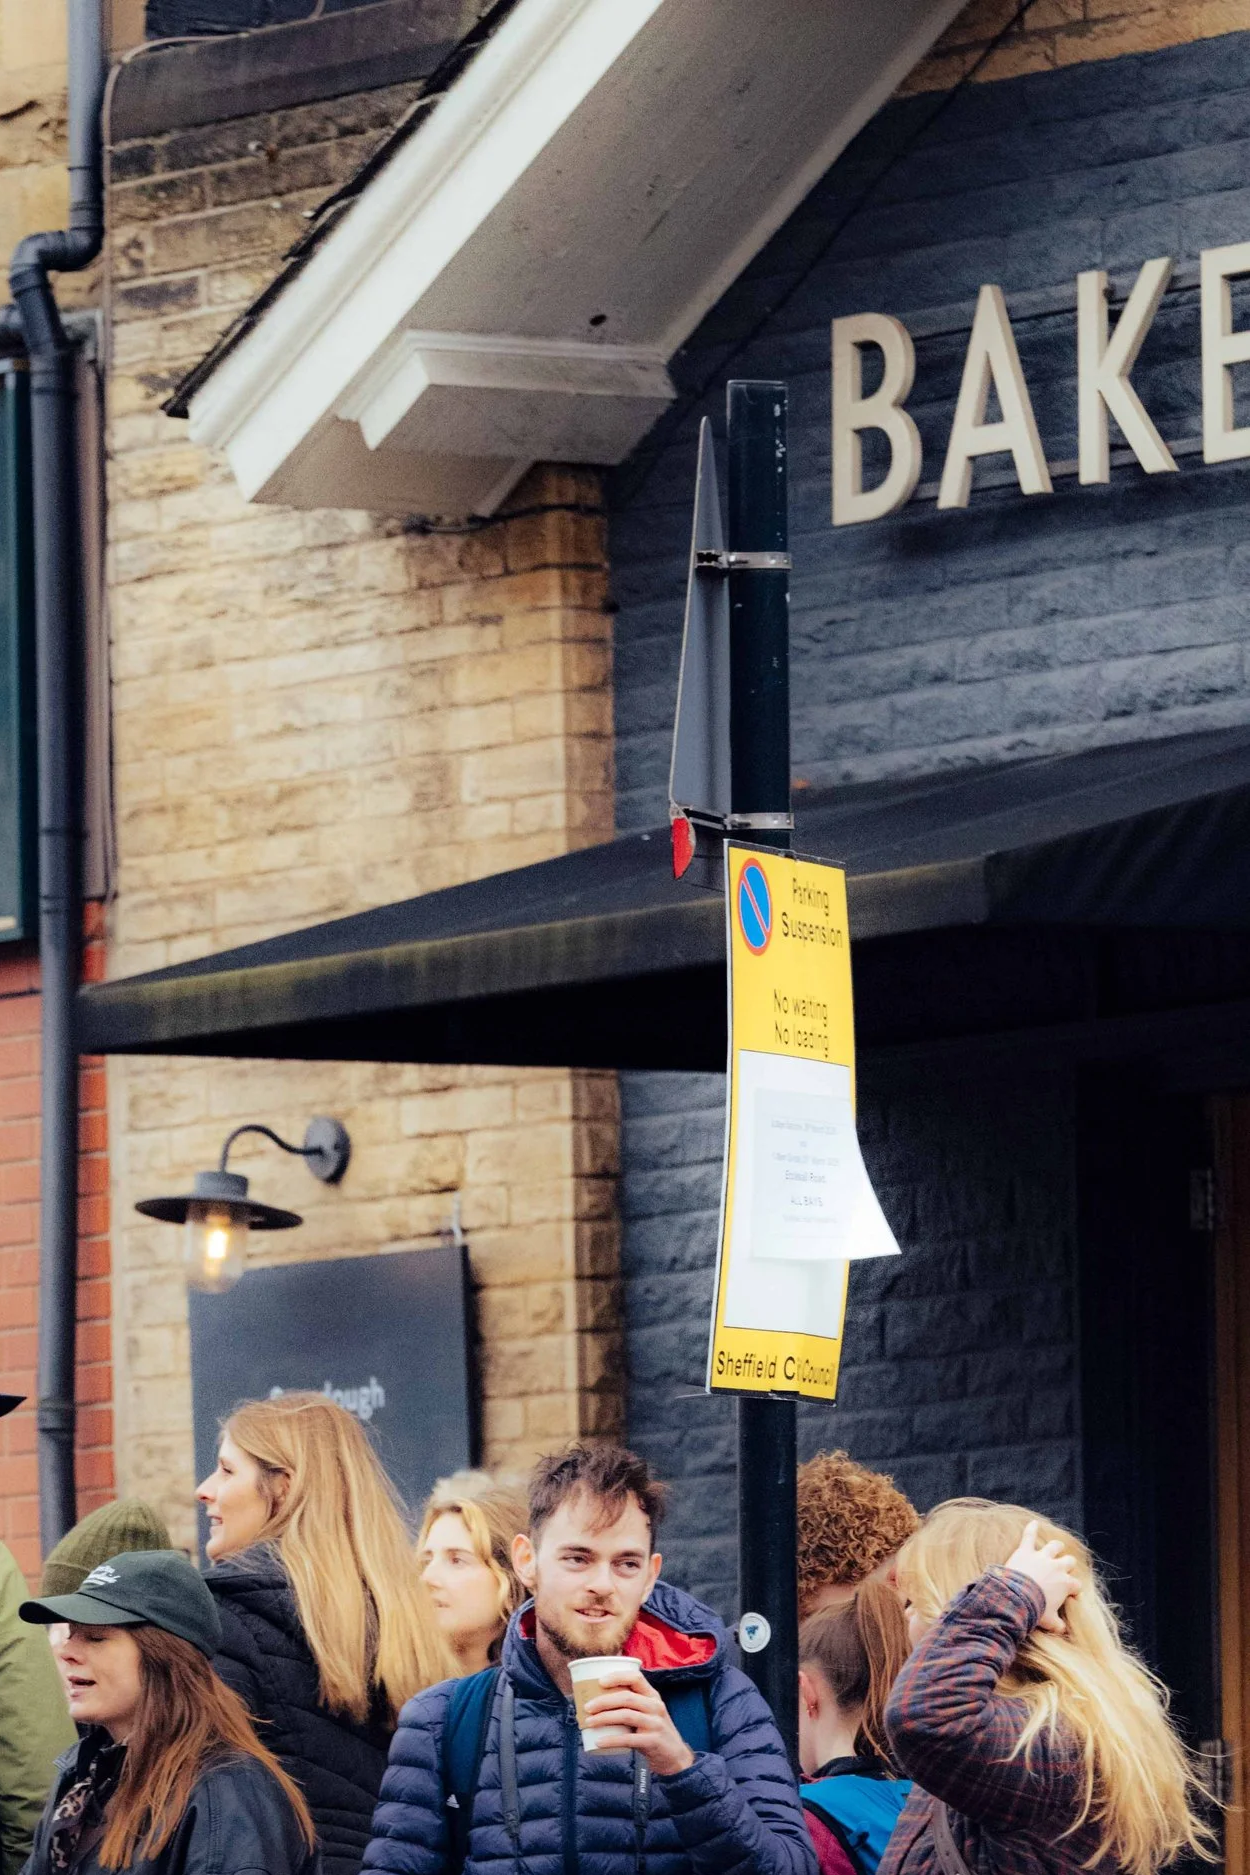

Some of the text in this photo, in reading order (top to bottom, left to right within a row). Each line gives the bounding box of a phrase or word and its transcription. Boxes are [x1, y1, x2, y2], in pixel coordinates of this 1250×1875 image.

[831, 240, 1250, 526] BAKE
[792, 877, 830, 918] Parking
[781, 911, 844, 949] Suspension
[773, 988, 828, 1028] No waiting
[774, 1020, 829, 1058] No loading
[716, 1350, 778, 1379] Sheffield
